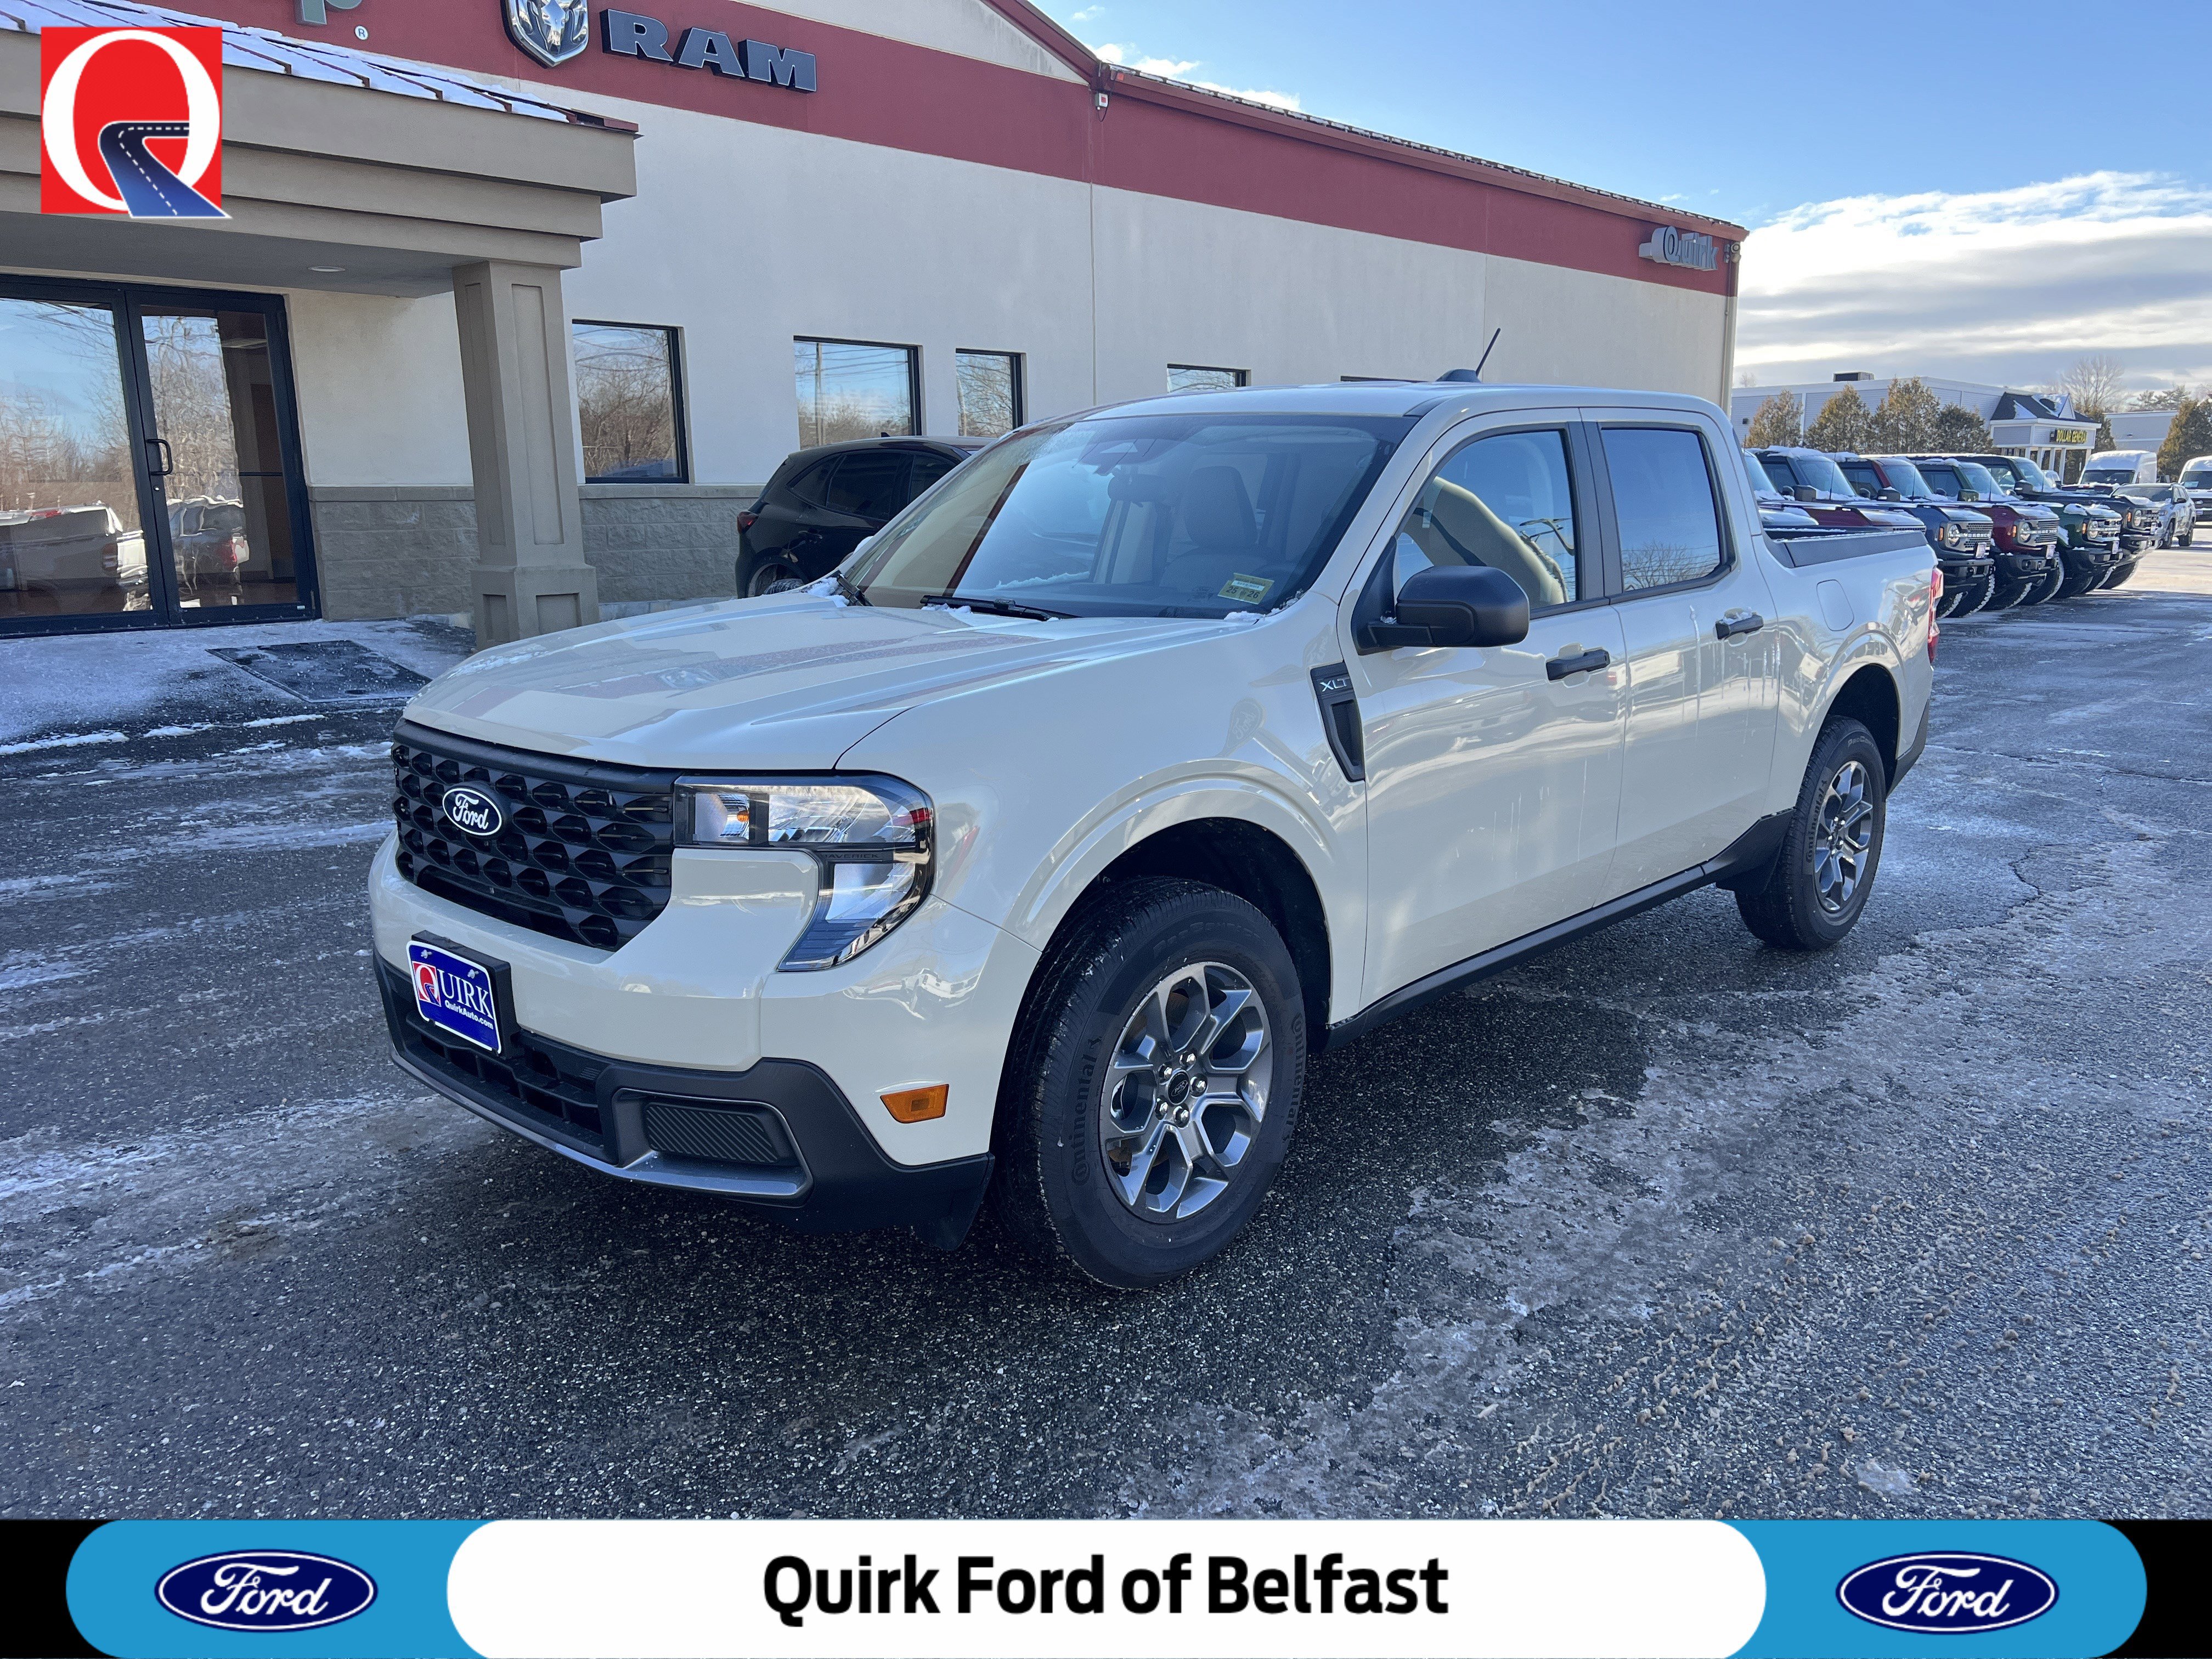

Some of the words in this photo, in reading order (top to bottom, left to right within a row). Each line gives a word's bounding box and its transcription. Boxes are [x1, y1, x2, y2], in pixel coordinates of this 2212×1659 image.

[602, 9, 817, 92] RAM
[1658, 225, 1718, 270] Quirk
[2056, 430, 2072, 442] DOLLAR
[1226, 586, 1238, 595] 25
[1246, 590, 1261, 599] 26
[1319, 676, 1350, 692] XLT
[453, 793, 489, 830] Ford
[414, 964, 494, 1020] QUIRK
[444, 1000, 494, 1029] QuirkAuto.com
[1070, 1054, 1097, 1186] Continental
